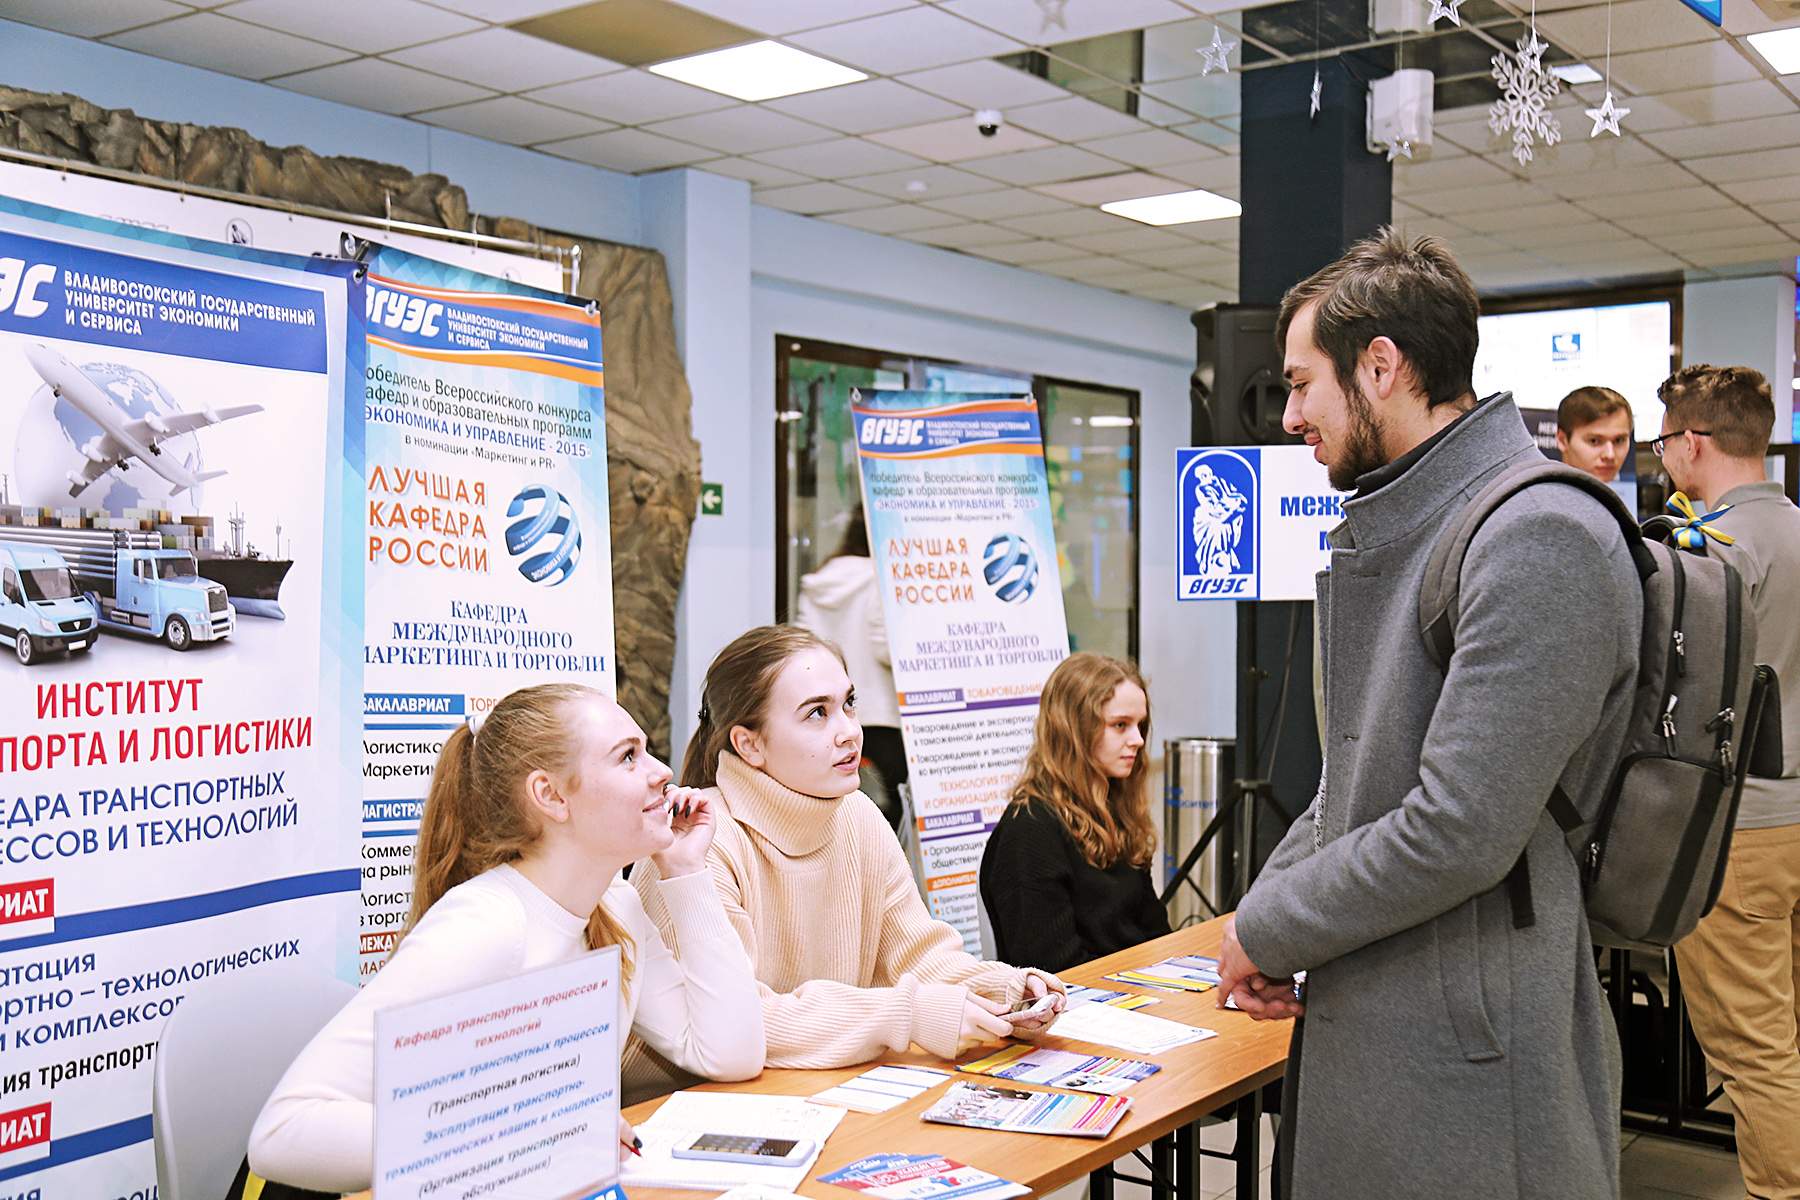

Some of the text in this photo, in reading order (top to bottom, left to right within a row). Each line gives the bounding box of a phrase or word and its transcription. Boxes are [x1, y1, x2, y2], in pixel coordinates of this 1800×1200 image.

[0, 257, 56, 319] ЭС
[64, 270, 315, 326] ВЛАДИВОСТОКСКИЙ ГОСУДАРСТВЕННЫЙ
[65, 290, 240, 332] УНИВЕРСИТЕТ ЭКОНОМИКИ
[65, 309, 143, 336] И СЕРВИСА
[447, 307, 589, 350] ВЛАДИВОСТОКСКИЙ ГОСУДАРСТВЕННЫЙ
[448, 320, 545, 351] УНИВЕРСИТЕТ ЭКОНОМИКИ
[448, 331, 491, 351] И СЕРВИСА
[366, 364, 592, 424] обедитель Всероссийского конкурса
[364, 405, 449, 434] ЭКОНОМИКА
[453, 420, 462, 437] И
[466, 423, 547, 453] УПРАВЛЕНИЕ
[366, 385, 592, 440] афедр и образовательных программ
[861, 418, 924, 446] ВГУЭС
[405, 433, 412, 445] в
[414, 436, 469, 458] номинации
[531, 456, 537, 467] и
[368, 465, 486, 507] ЛУЧШАЯ
[369, 500, 487, 540] КАФЕДРА
[369, 536, 488, 573] РОССИИ
[889, 538, 969, 557] ЛУЧШАЯ
[892, 562, 971, 580] КАФЕДРА
[1189, 579, 1248, 594] ВГУЭС
[451, 600, 529, 624] КАФЕДРА
[895, 586, 975, 604] РОССИИ
[392, 621, 573, 651] МЕЖДУНАРОДНОГО
[916, 635, 1040, 655] МЕЖДУНАРОДНОГО
[947, 621, 1006, 636] КАФЕДРА
[497, 654, 508, 669] И
[511, 653, 606, 673] ТОРГОВЛИ
[899, 649, 1064, 673] МАРКЕТИНГА И ТОРГОВЛИ
[37, 679, 203, 719] ИНСТИТУТ
[966, 683, 1042, 699] ТОВАРОВЕДЕНИ
[0, 716, 313, 773] ПОРТА И ЛОГИСТИКИ
[991, 744, 1031, 757] эксперти
[363, 763, 434, 780] Маркети
[988, 758, 1024, 768] внешне
[79, 771, 286, 816] ТРАНСПОРТНЫХ
[363, 801, 425, 820] АГИСТРА
[0, 797, 299, 866] ССОВ И ТЕХНОЛОГИЙ
[380, 865, 415, 881] рын
[931, 854, 979, 869] обществен
[361, 892, 411, 907] огист
[0, 953, 96, 988] атация
[0, 988, 74, 1025] ртно
[101, 939, 300, 1000] технологических
[394, 979, 608, 1049] Кафедра транспортных процессов и
[474, 1019, 542, 1049] технологий
[0, 1041, 159, 1099] ия транспорт
[392, 1022, 610, 1101] Технология транспортных процессов
[427, 1054, 581, 1119] (Транспортная логистика)
[0, 1112, 47, 1147] ИАТ
[385, 1135, 494, 1181] технологических
[499, 1117, 538, 1137] машин
[551, 1088, 614, 1119] комплексов
[423, 1107, 509, 1144] Эксплуатация
[418, 1122, 588, 1199] (Организация транспортного
[462, 1156, 552, 1200] обслуживания)
